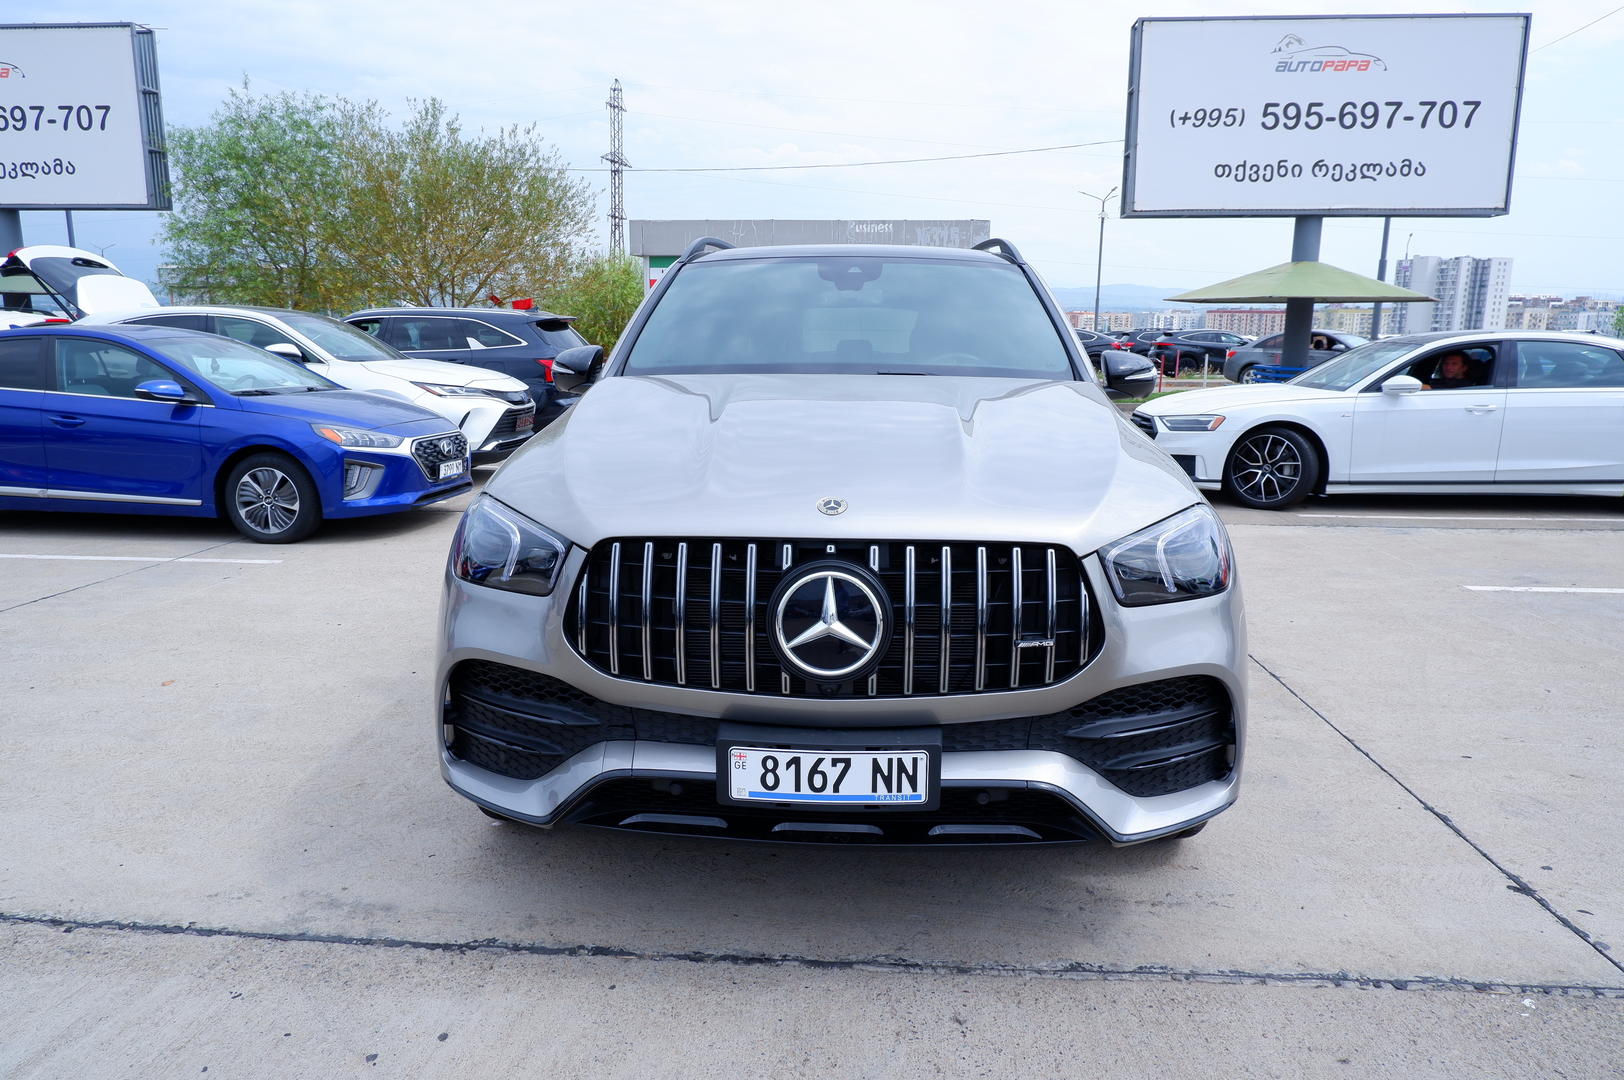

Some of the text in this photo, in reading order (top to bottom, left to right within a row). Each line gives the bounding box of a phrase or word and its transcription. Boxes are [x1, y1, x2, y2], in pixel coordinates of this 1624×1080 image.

[1169, 100, 1482, 130] (+995) 595-697-707
[1214, 159, 1427, 183] თქვენი რეკლამა
[734, 761, 747, 770] GE
[760, 755, 918, 793] 8167 NN
